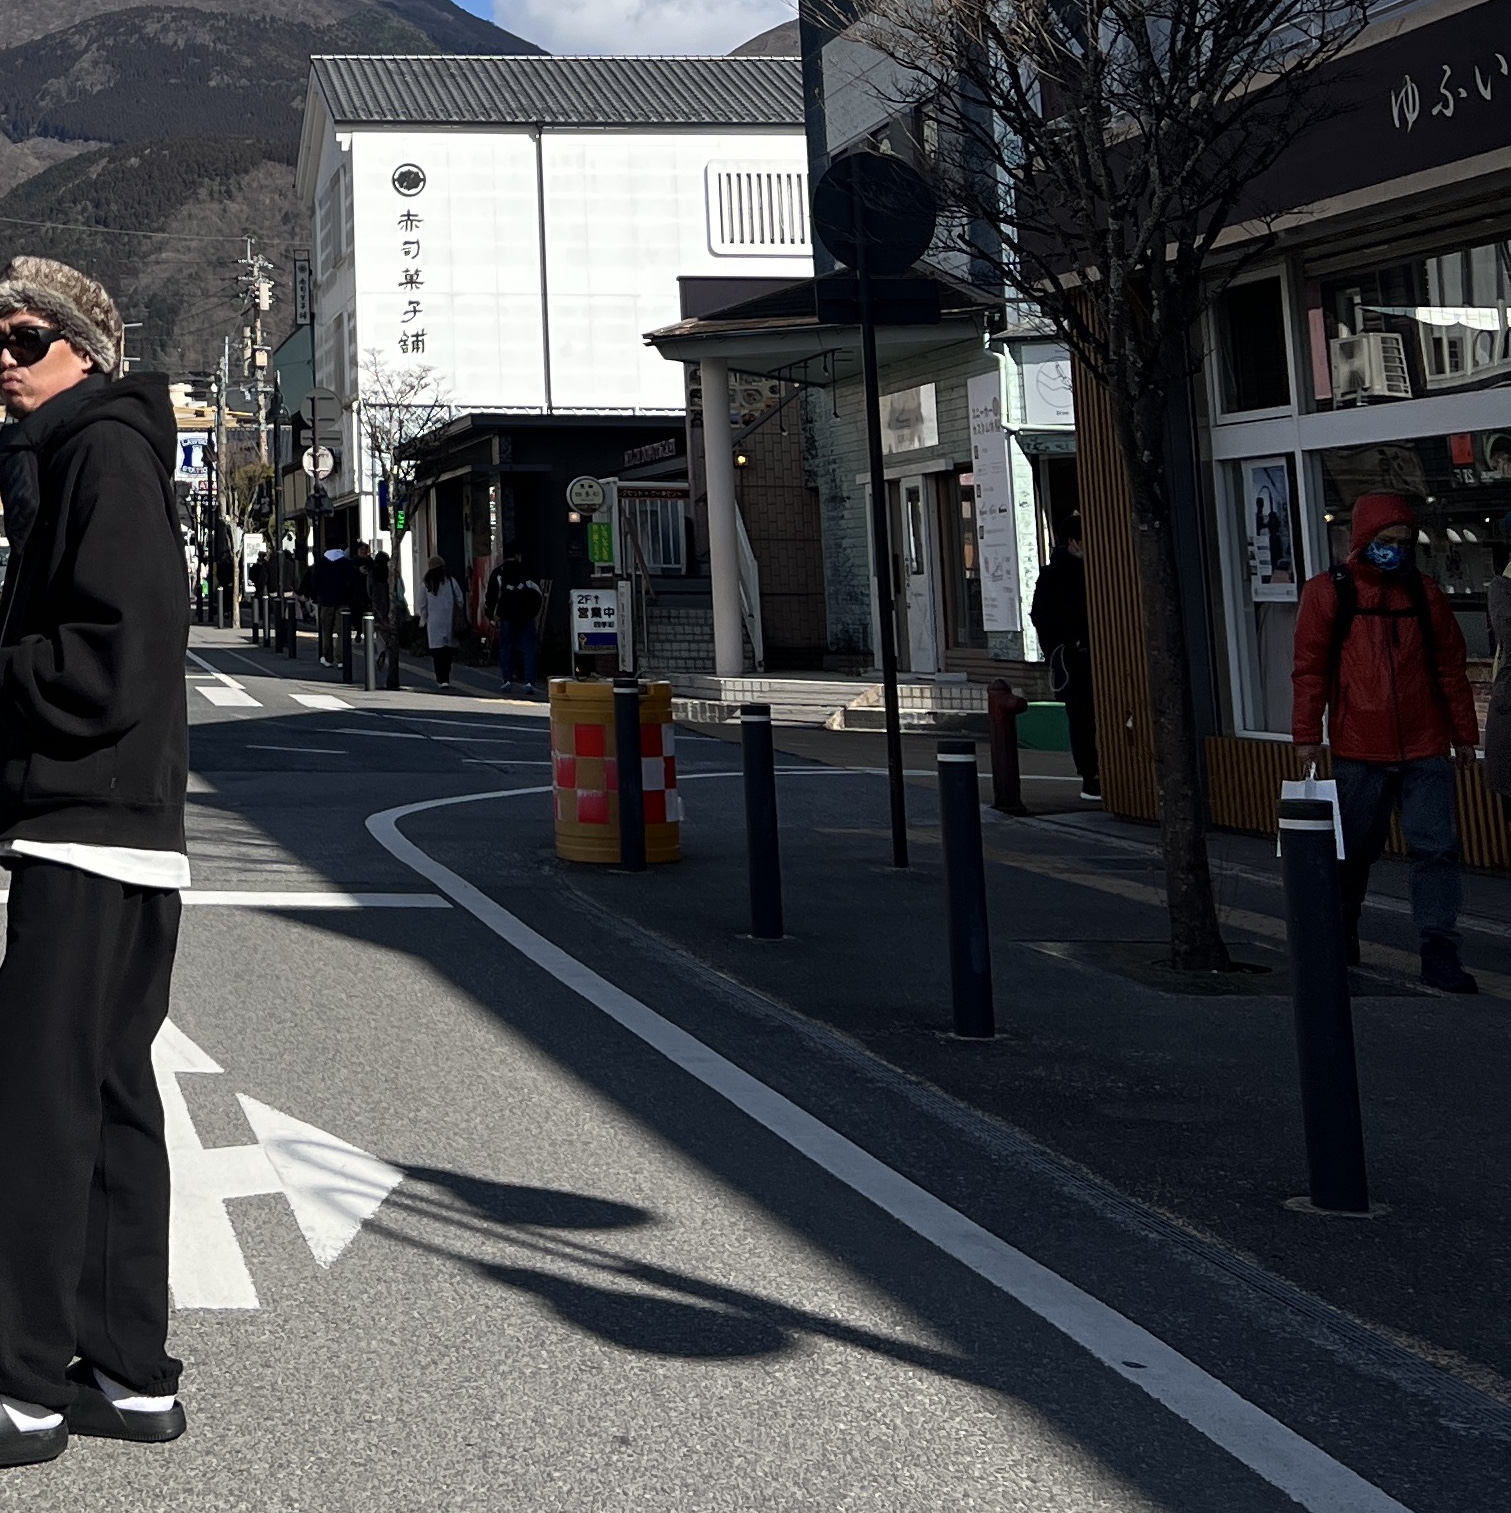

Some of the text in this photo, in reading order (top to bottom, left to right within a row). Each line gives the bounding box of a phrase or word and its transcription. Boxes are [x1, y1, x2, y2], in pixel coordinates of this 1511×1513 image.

[397, 208, 428, 355] 赤司菓子舗
[577, 607, 615, 619] 営業中
